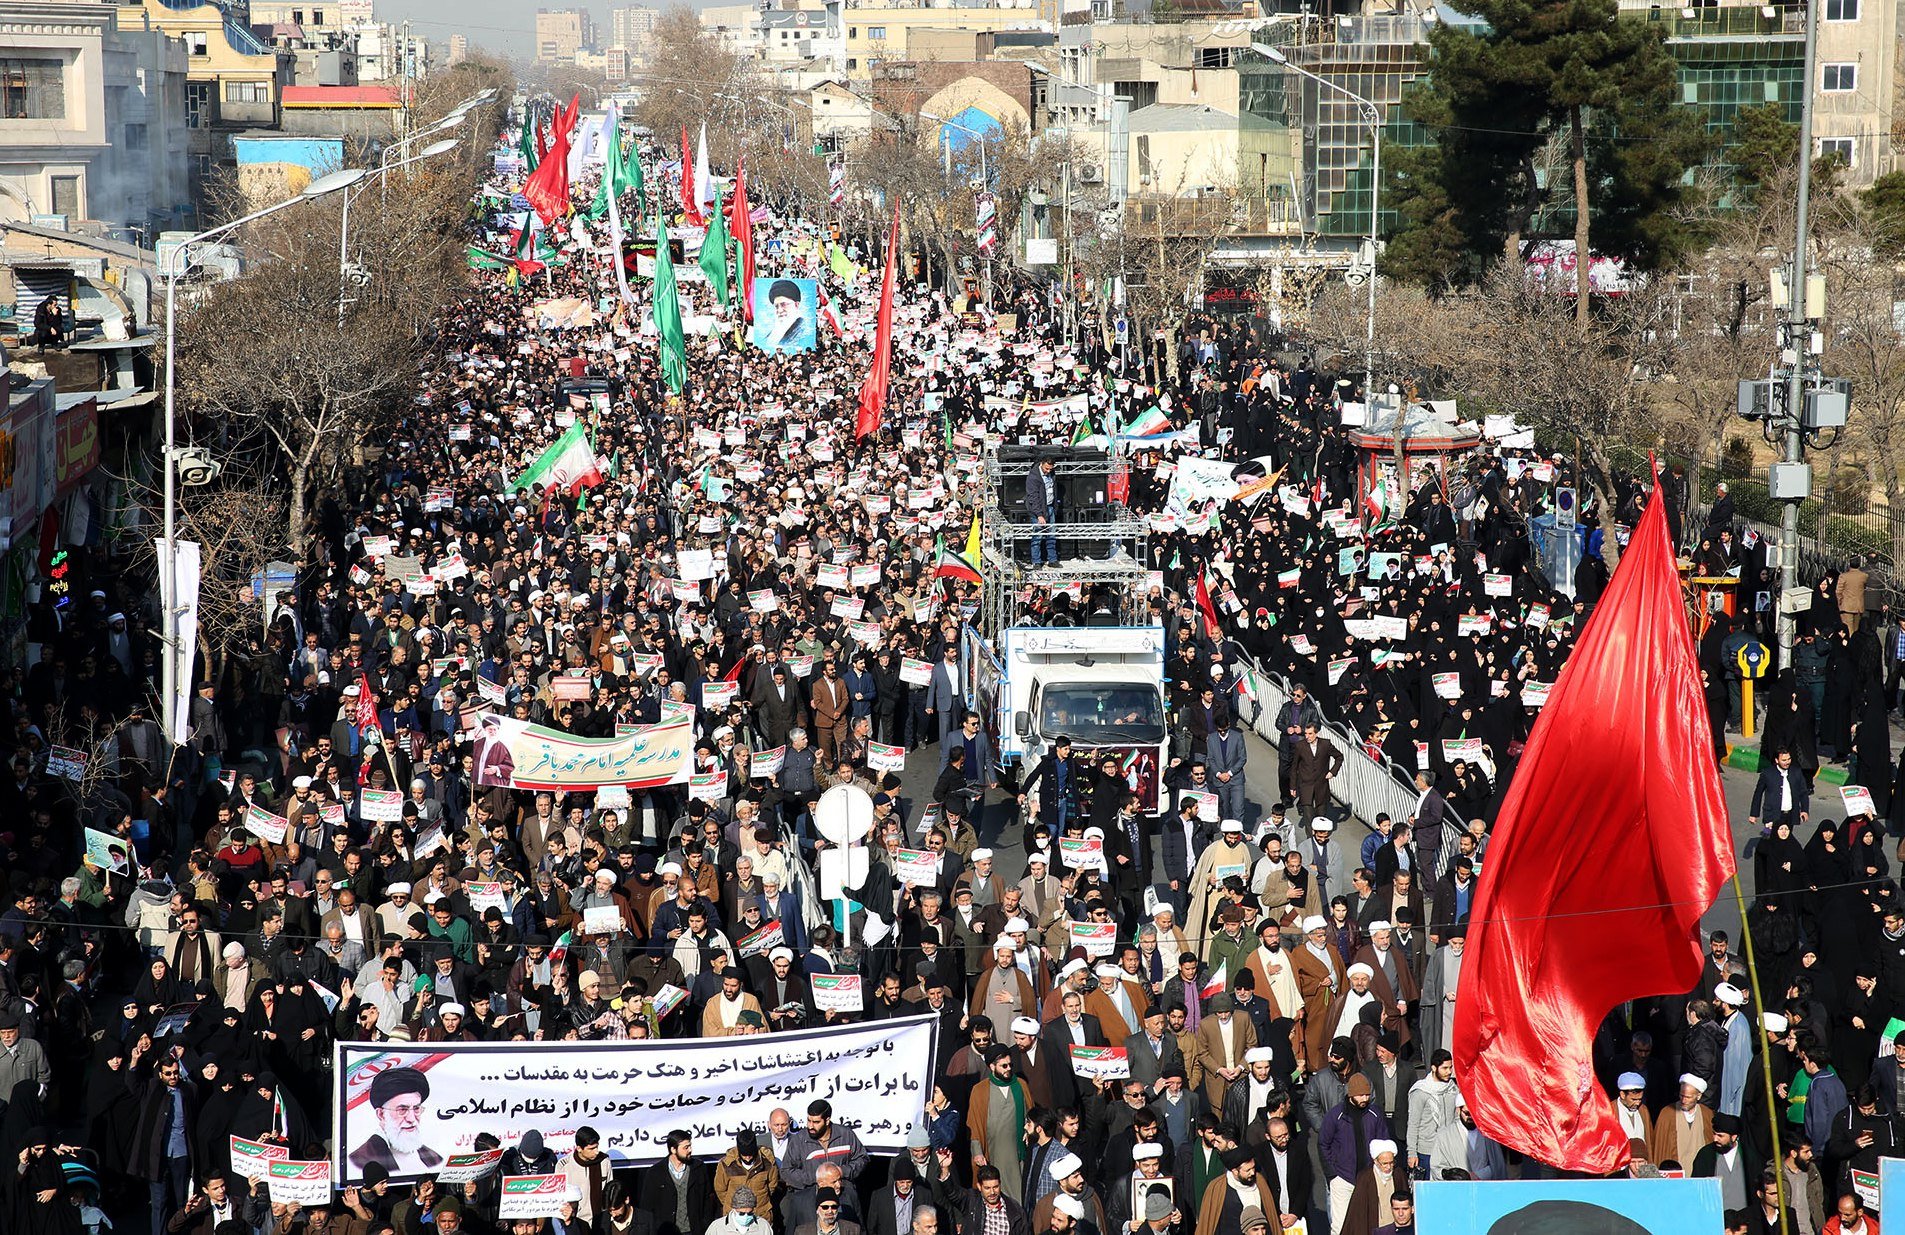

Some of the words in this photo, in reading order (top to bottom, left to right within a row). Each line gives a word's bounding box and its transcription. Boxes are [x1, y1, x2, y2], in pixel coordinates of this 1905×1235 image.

[57, 416, 97, 482] جهان
[529, 744, 559, 778] باقر
[560, 752, 584, 772] محمد
[580, 751, 613, 774] امام
[613, 737, 648, 776] علمیه
[637, 745, 681, 766] مدرسه
[826, 1051, 840, 1063] به
[843, 1041, 880, 1060] توجه
[883, 1039, 894, 1056] با
[703, 1058, 738, 1079] اخیر
[741, 1049, 822, 1071] اغتشاشات
[503, 1064, 569, 1082] مقدسات
[572, 1065, 588, 1084] به
[591, 1064, 643, 1085] حرمت
[647, 1062, 686, 1079] هتک
[690, 1067, 699, 1080] و
[825, 1074, 841, 1099] از
[903, 1072, 919, 1091] ما
[436, 1098, 507, 1121] اسلامی
[509, 1099, 556, 1120] نظام
[559, 1098, 579, 1118] از
[582, 1098, 599, 1118] را
[604, 1097, 644, 1119] خود
[648, 1093, 711, 1112] حمایت
[716, 1093, 726, 1106] و
[866, 1118, 901, 1135] رهبر
[903, 1122, 912, 1135] و
[607, 1128, 650, 1148] داریم
